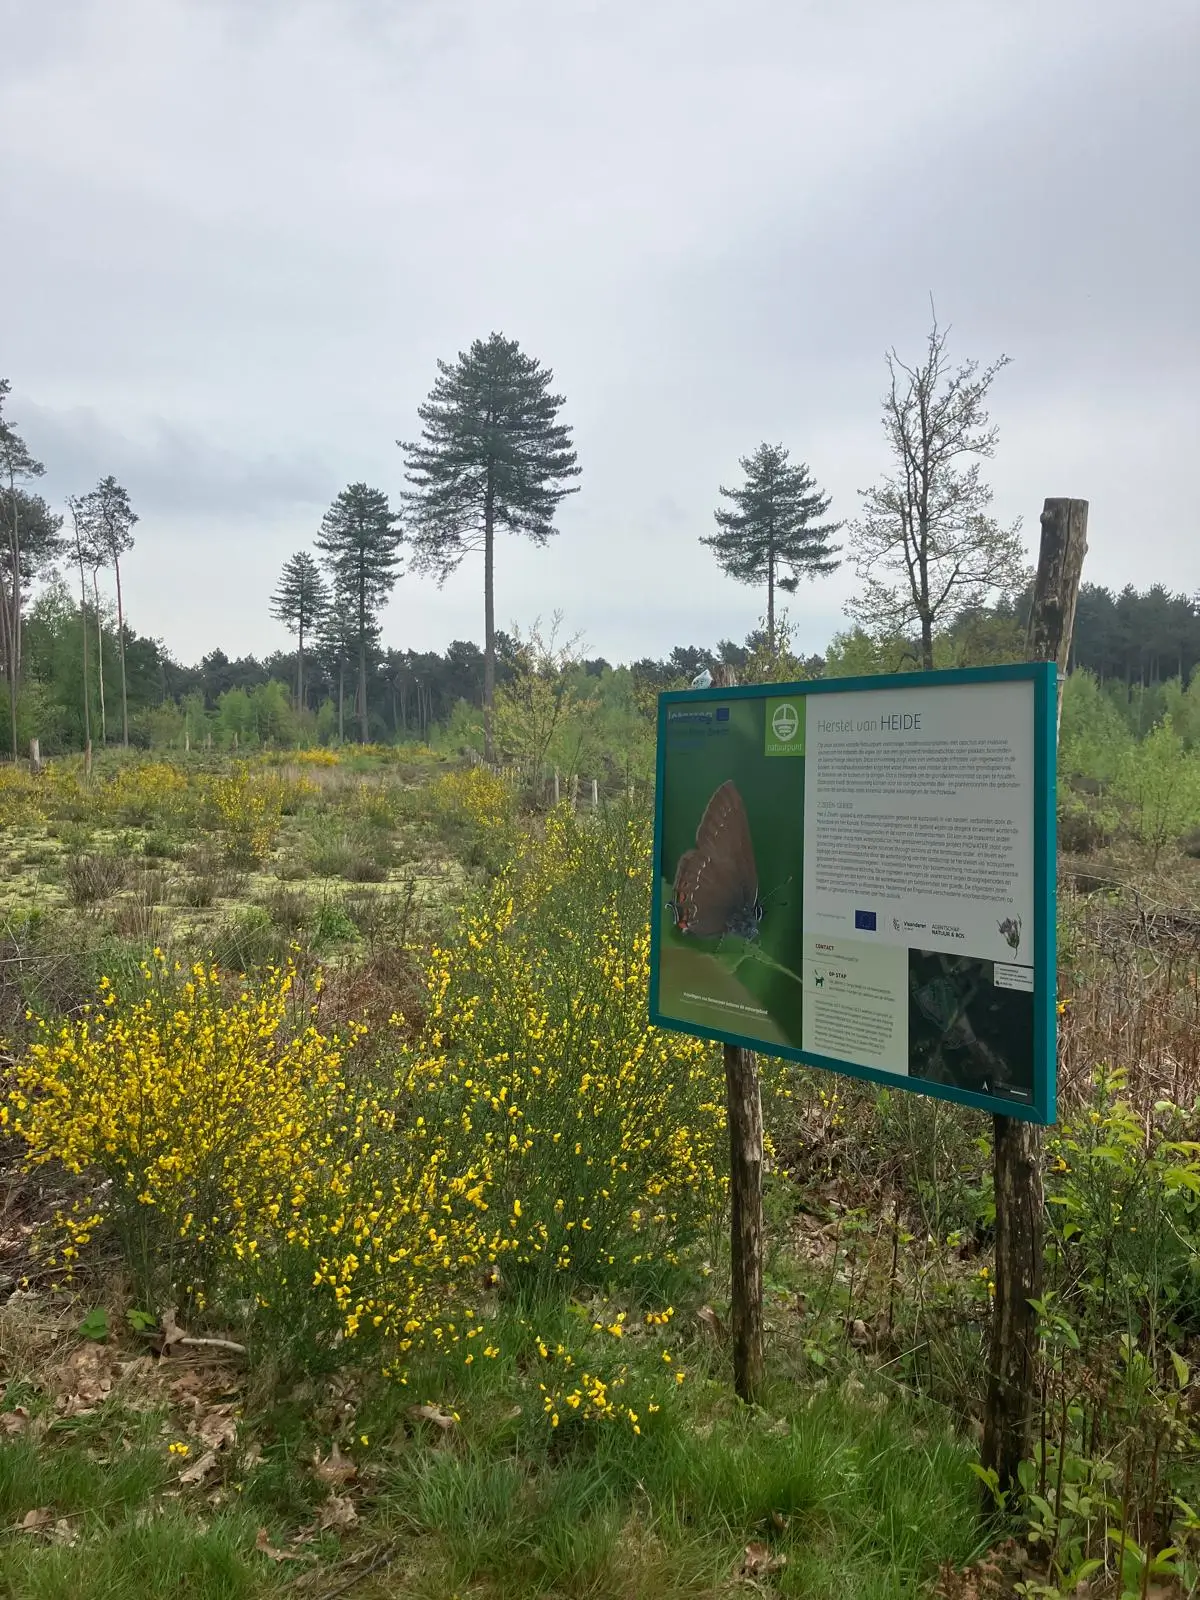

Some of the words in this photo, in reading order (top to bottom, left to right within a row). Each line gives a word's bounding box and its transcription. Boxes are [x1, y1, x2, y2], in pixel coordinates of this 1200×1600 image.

[817, 719, 854, 732] Herstel
[857, 719, 877, 732] van
[880, 712, 922, 731] HEIDE
[815, 943, 834, 951] CONTACT
